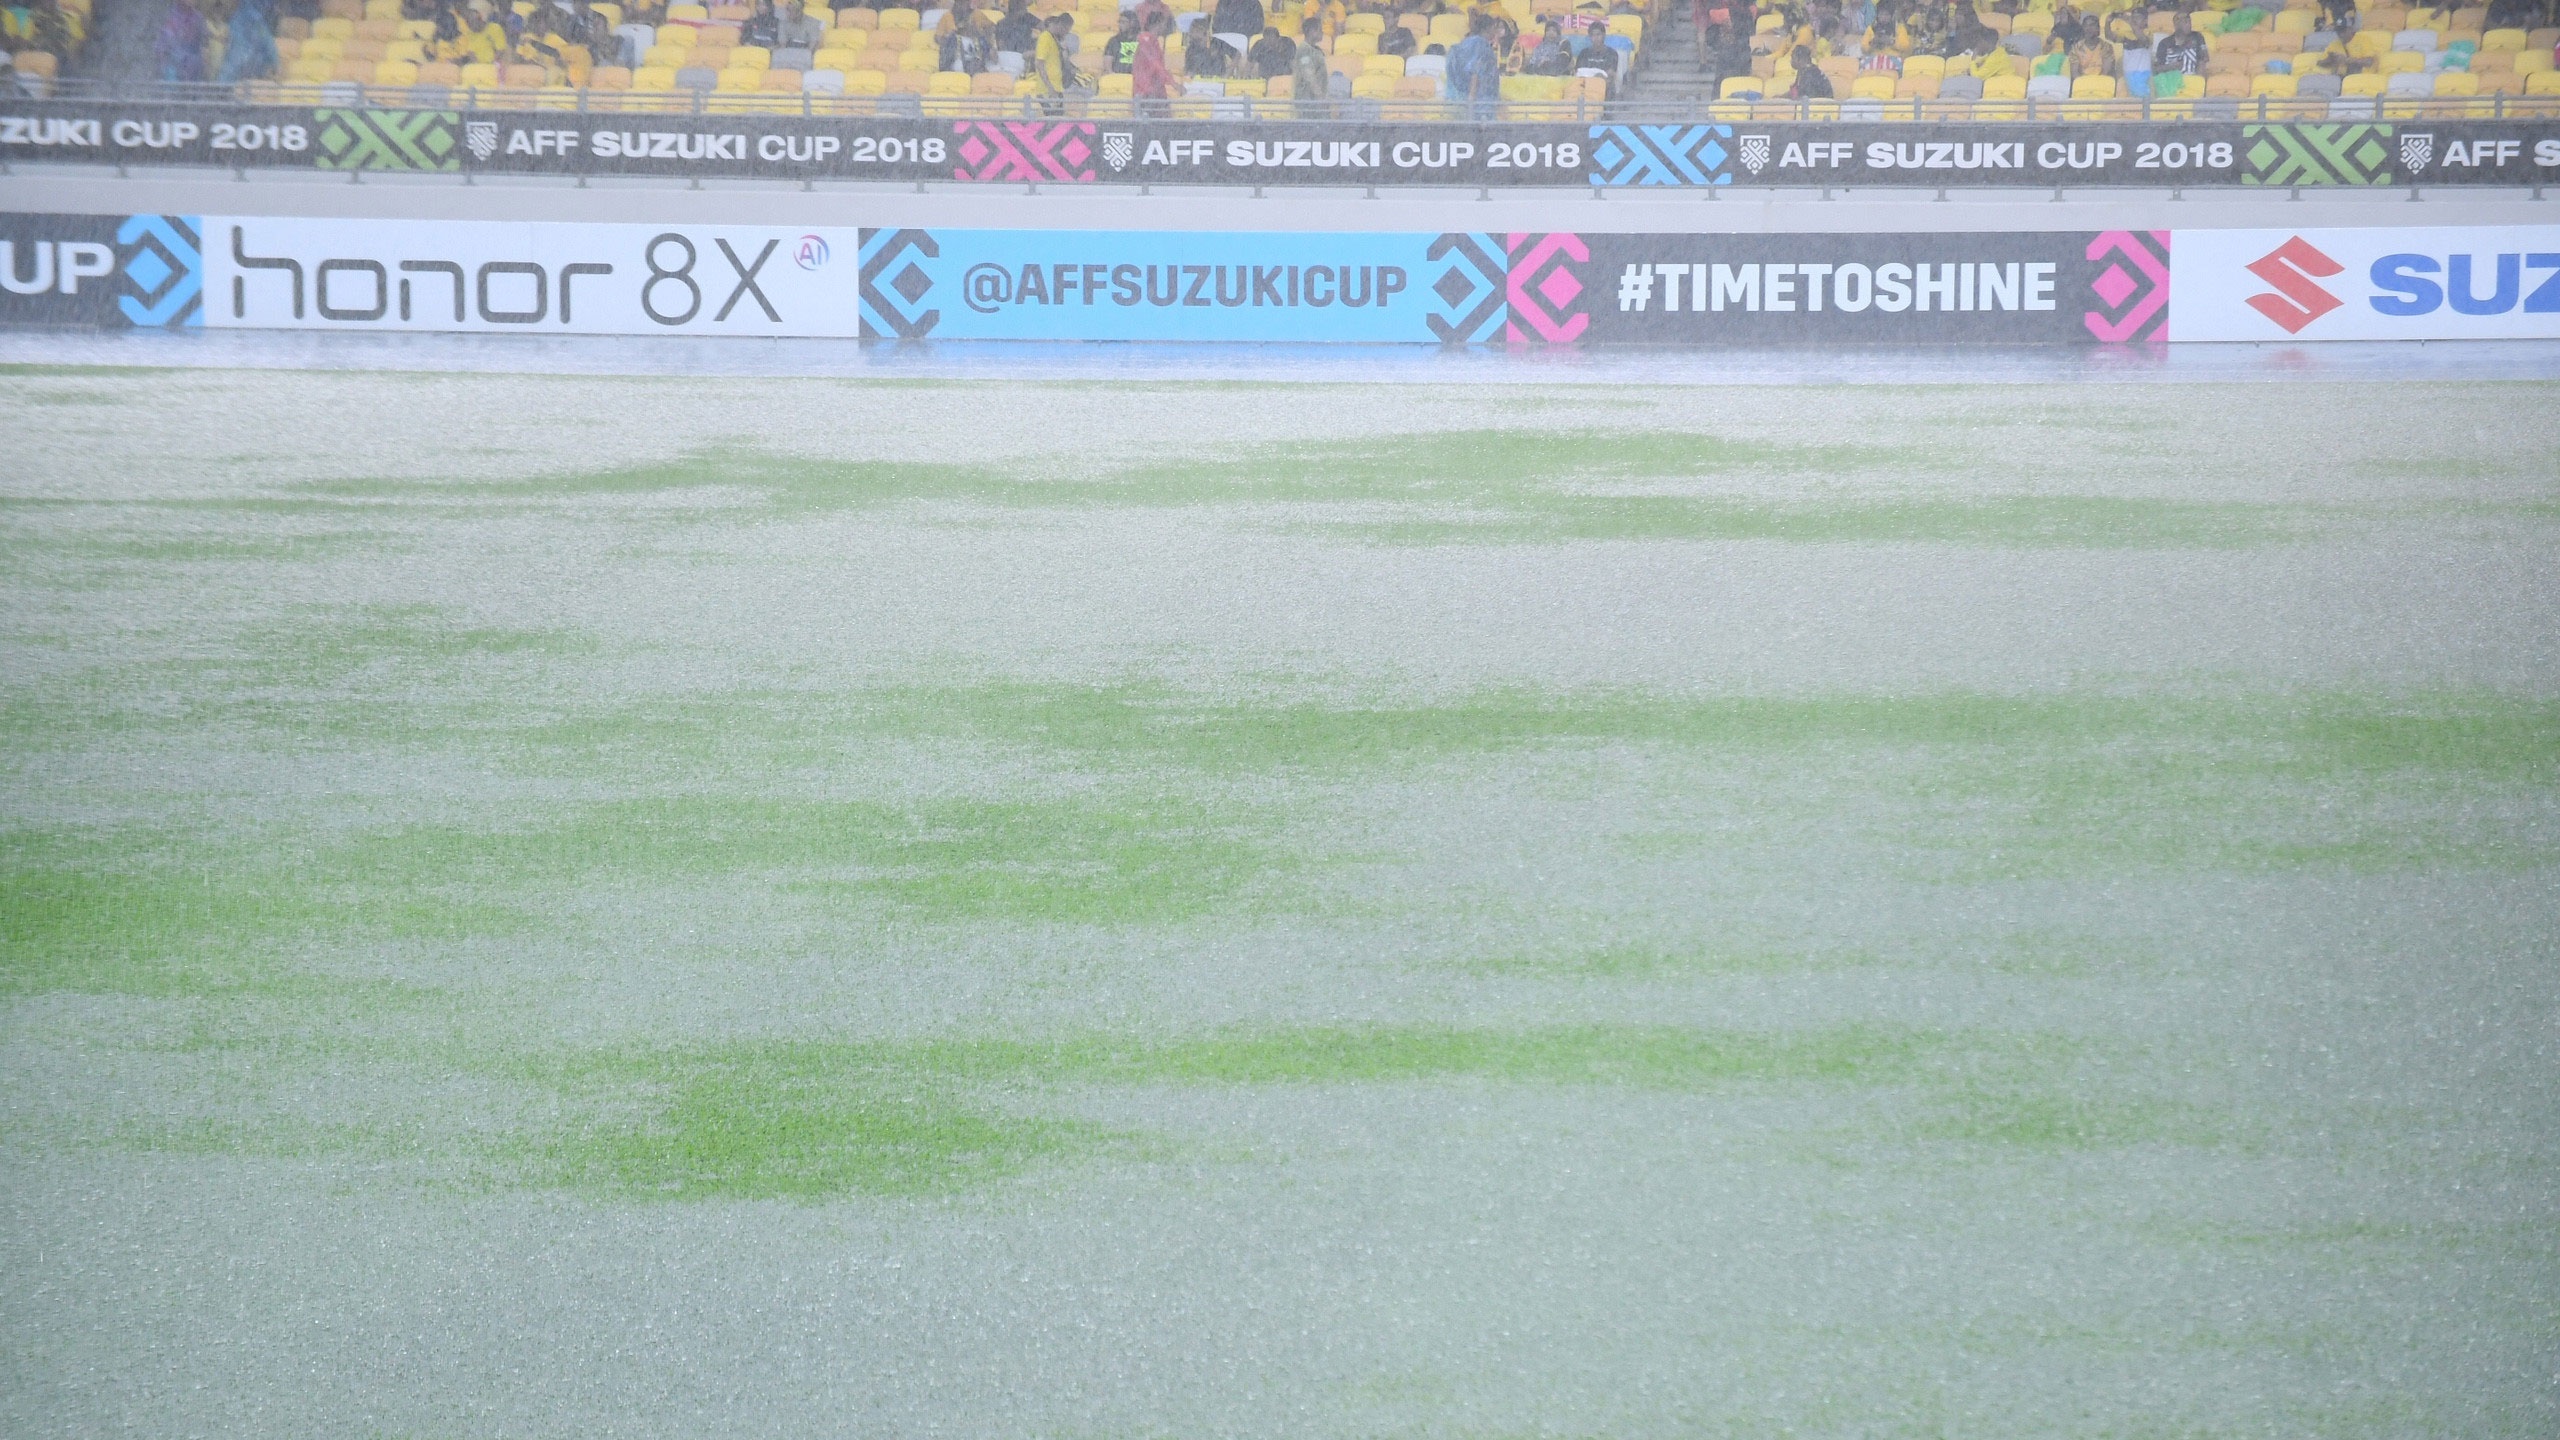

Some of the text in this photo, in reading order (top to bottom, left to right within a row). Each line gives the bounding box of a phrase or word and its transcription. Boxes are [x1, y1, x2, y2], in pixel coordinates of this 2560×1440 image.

[111, 119, 200, 148] CUP
[210, 122, 309, 152] 2018
[505, 129, 947, 164] AFF SUZUKI CUP 2018
[1141, 139, 1581, 169] AFF SUZUKI CUP 2018
[1778, 141, 2234, 169] AFF SUZUKI CUP 2018
[2441, 140, 2521, 167] AFF
[0, 240, 115, 295] UP
[231, 225, 783, 326] honor 8X
[963, 261, 1407, 314] @AFFSUZUKICUP
[1617, 262, 2056, 312] #TIMETOSHINE
